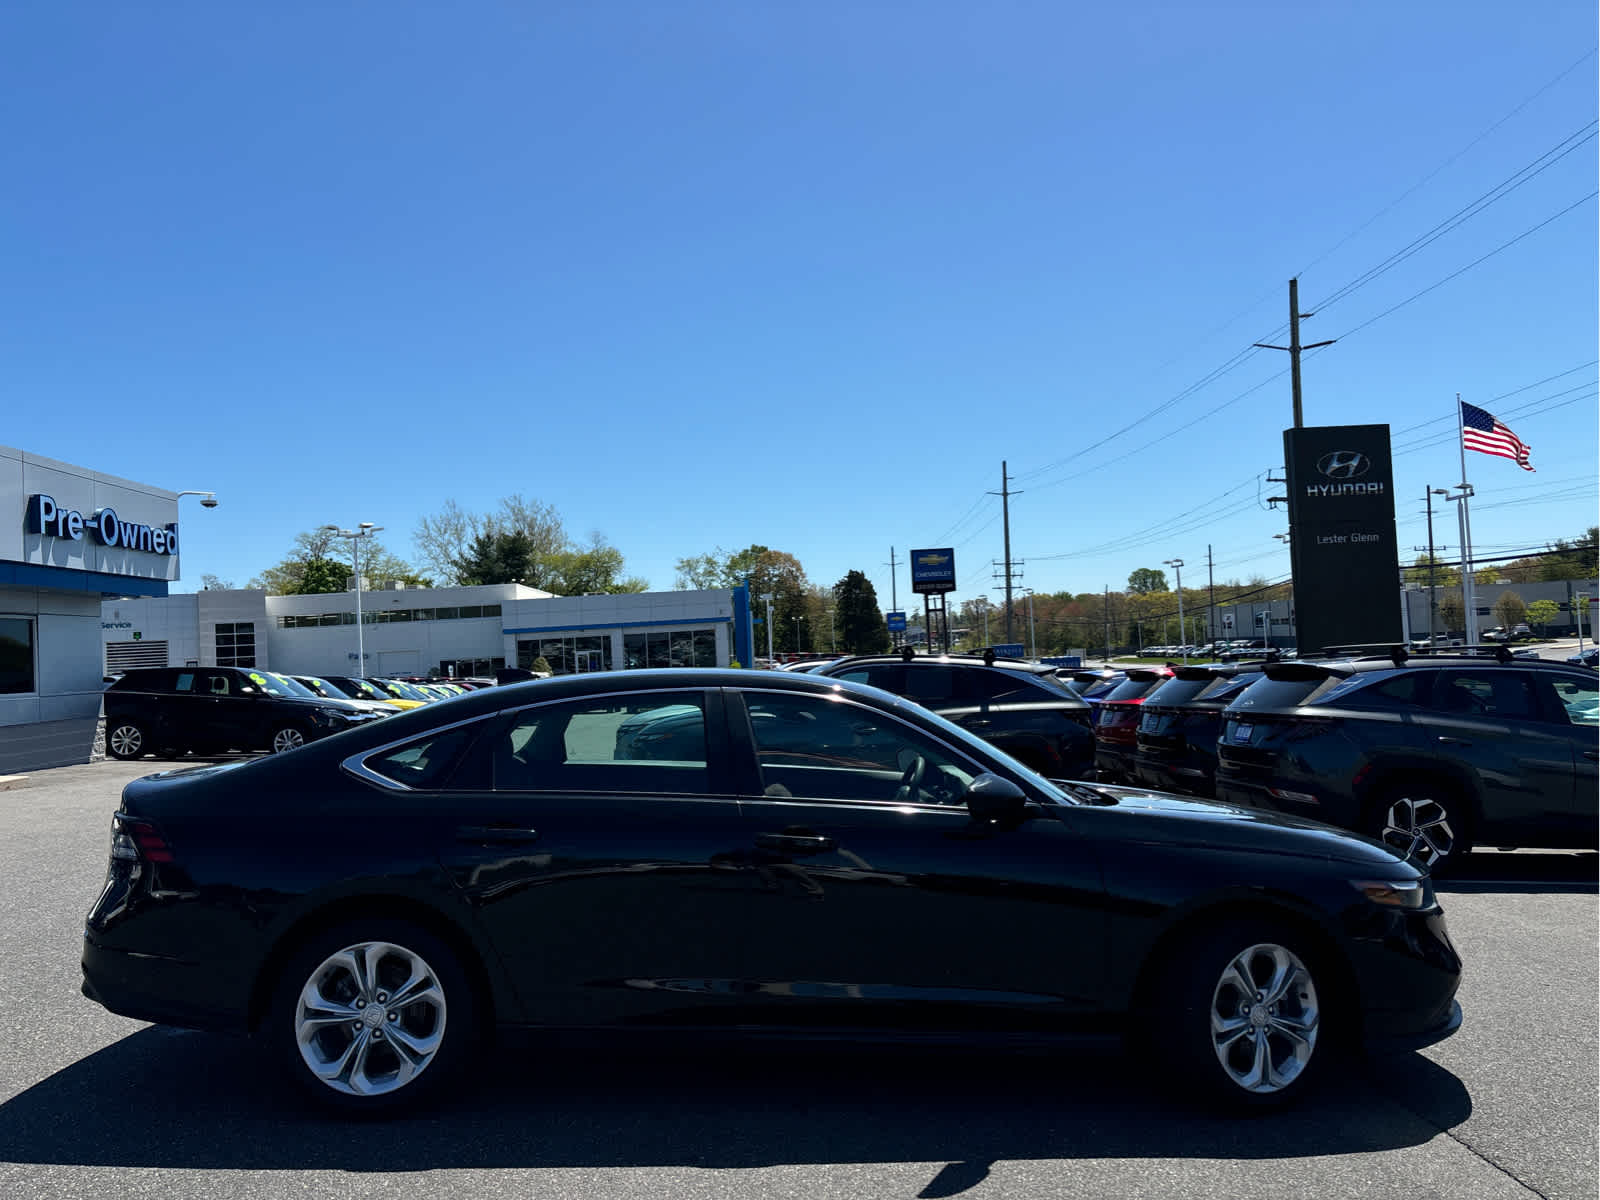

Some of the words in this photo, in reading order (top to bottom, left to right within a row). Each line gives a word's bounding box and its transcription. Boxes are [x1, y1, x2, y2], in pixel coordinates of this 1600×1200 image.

[1306, 482, 1384, 497] HYUNDAI
[36, 495, 178, 555] Pre-Owned
[1316, 533, 1348, 545] Lester
[1351, 532, 1380, 543] Glenn
